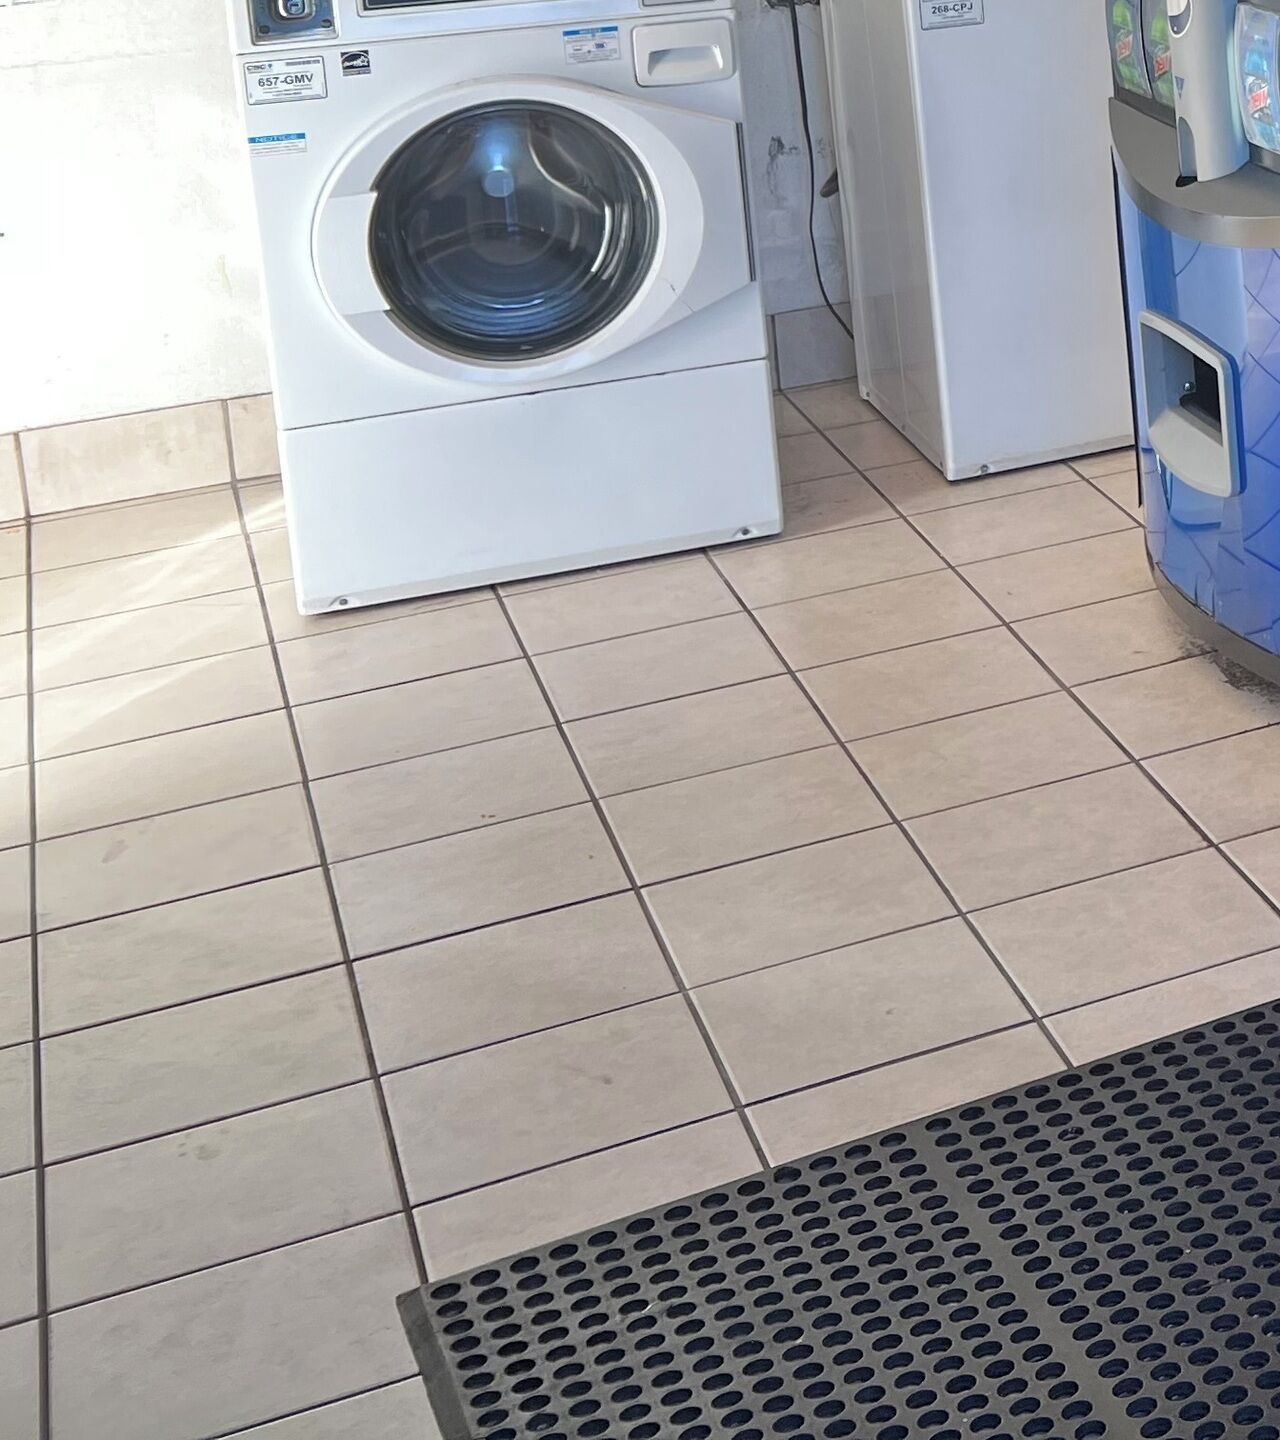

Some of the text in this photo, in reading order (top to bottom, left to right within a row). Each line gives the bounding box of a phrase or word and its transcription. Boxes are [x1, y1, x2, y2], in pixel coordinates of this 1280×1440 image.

[931, 2, 973, 15] 268-CPJ
[257, 72, 314, 88] 657-GMV
[255, 133, 299, 144] NOTICE
